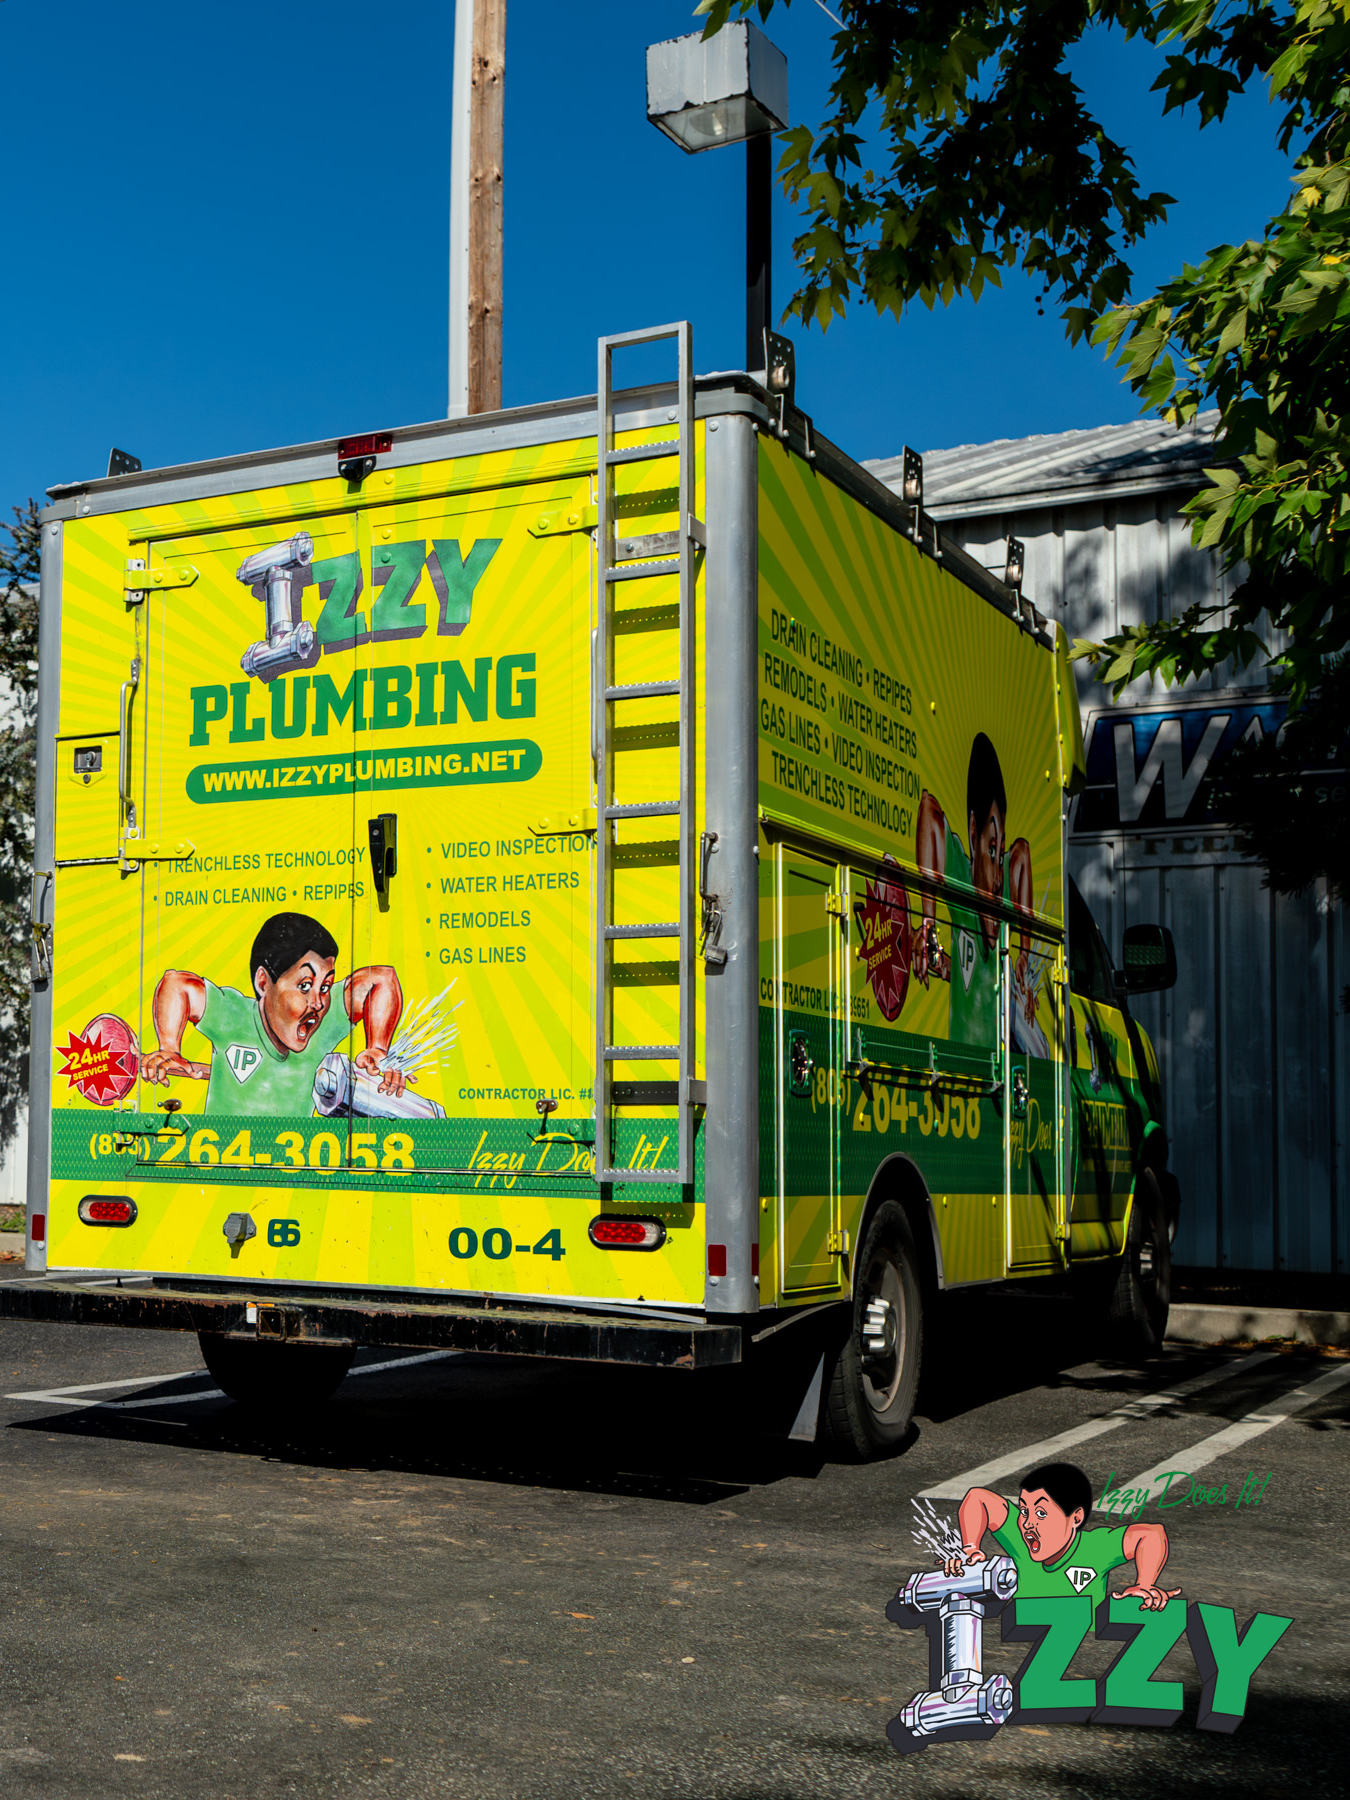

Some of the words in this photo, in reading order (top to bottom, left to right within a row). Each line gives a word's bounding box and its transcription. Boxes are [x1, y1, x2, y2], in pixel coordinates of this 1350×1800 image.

[236, 532, 502, 684] IZZY
[771, 608, 806, 657] DRAIN
[809, 631, 863, 688] CLEANING
[873, 668, 912, 716] REPIPES
[189, 653, 536, 747] PLUMBING
[764, 652, 827, 713] REMODELS
[838, 691, 873, 736] WATER
[875, 713, 917, 759] HEATERS
[760, 698, 785, 738] GAS
[788, 711, 821, 755] LINES
[831, 732, 863, 775] VIDEO
[865, 749, 920, 801] INSPECTION
[203, 749, 526, 793] WWW.IZZYPLUMBING.NET
[771, 750, 845, 810] TRENCHLESS
[847, 784, 912, 838] TECHNOLOGY
[168, 854, 261, 873] TRENCHLESS
[265, 847, 366, 869] TECHNOLOGY
[441, 841, 491, 859] VIDEO
[496, 836, 595, 857] INSPECTION
[165, 890, 208, 907] DRAIN
[213, 886, 287, 904] CLEANING
[304, 881, 365, 901] REPIPES
[440, 876, 497, 894] WATER
[503, 872, 580, 891] HEATERS
[439, 910, 531, 929] REMODELS
[439, 948, 473, 964] GAS
[479, 946, 526, 963] LINES
[868, 944, 892, 970] SERVICE
[233, 1048, 257, 1070] IP
[72, 1064, 109, 1082] SERVICE
[458, 1087, 546, 1100] CONTRACTOR
[551, 1087, 575, 1100] LIC.
[155, 1127, 415, 1177] 264-3058
[468, 1130, 526, 1189] Izzy
[448, 1226, 566, 1261] 00-4
